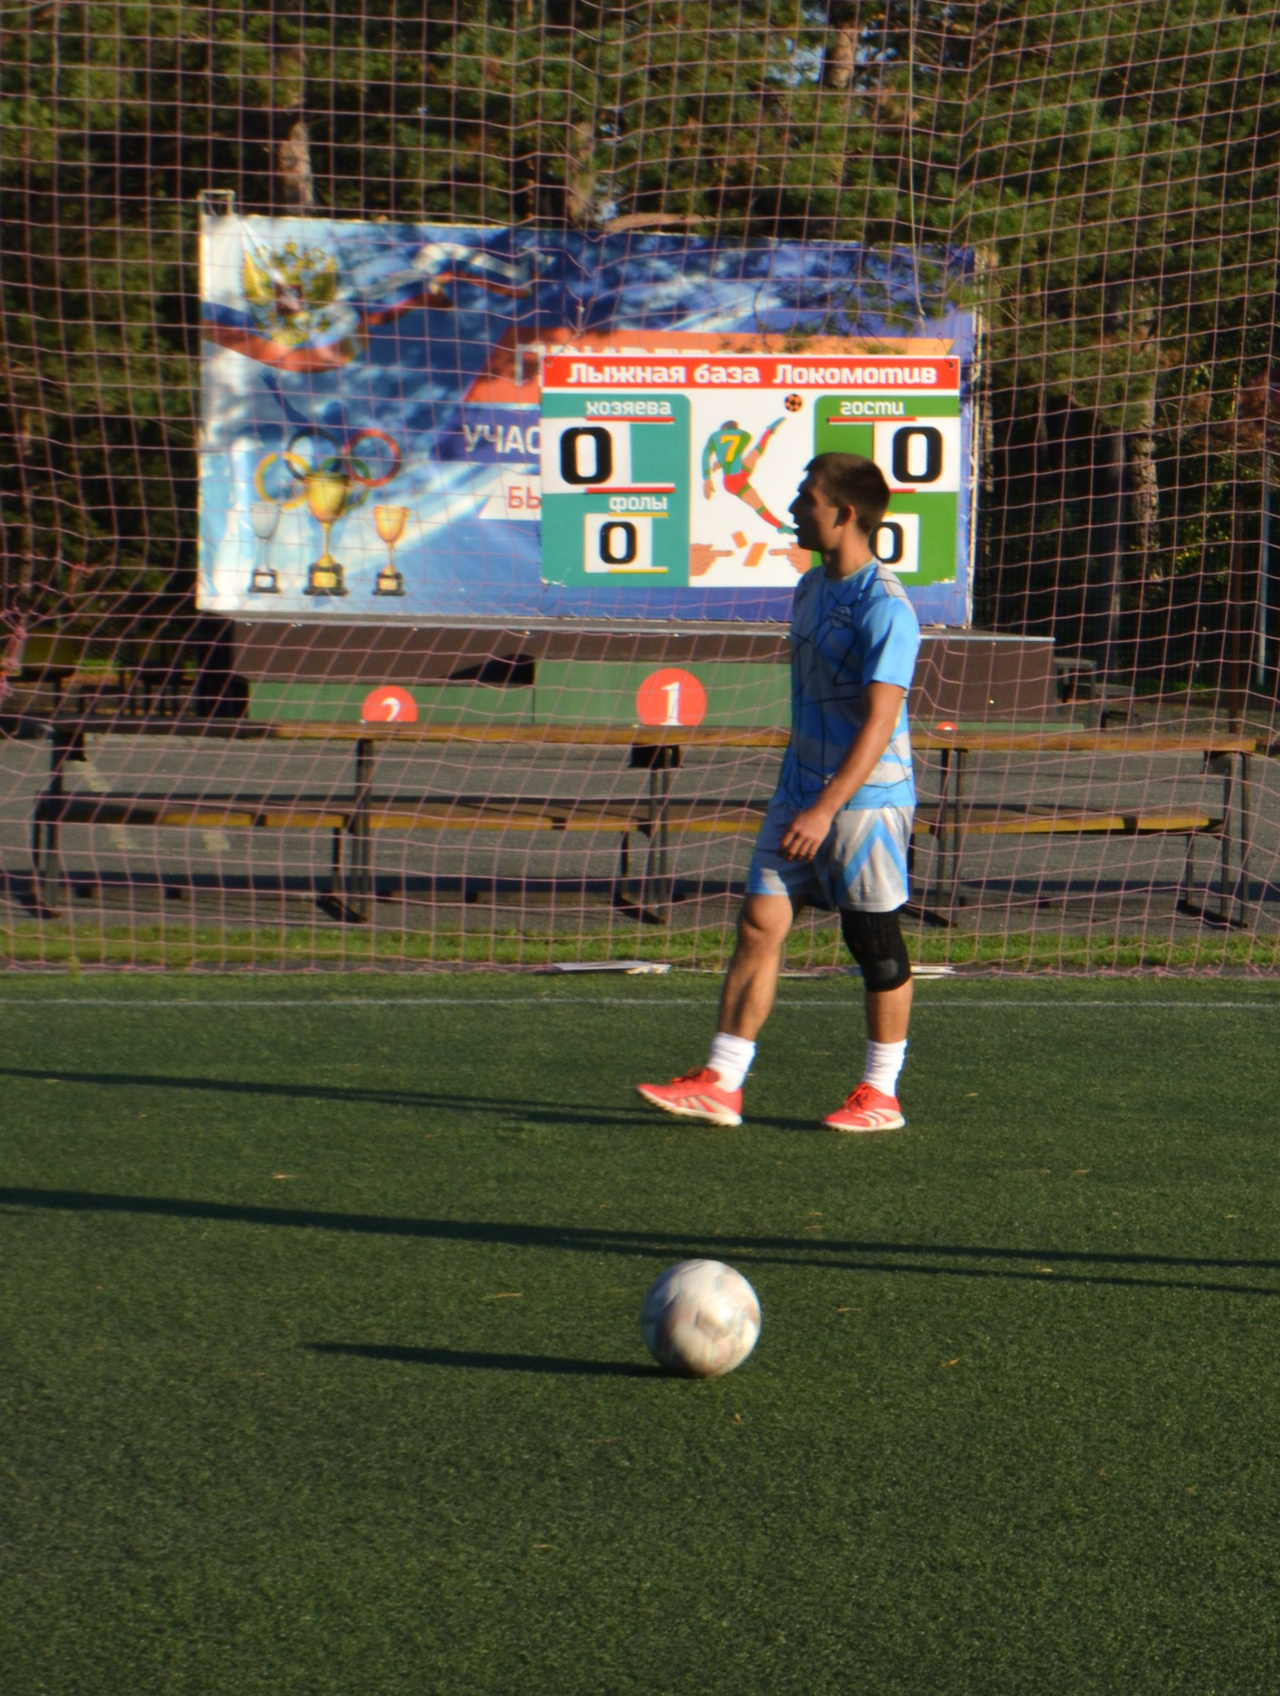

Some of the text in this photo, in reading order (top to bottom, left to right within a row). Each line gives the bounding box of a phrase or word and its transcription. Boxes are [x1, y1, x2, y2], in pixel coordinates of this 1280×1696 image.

[567, 363, 938, 384] Лыжная база Локомотив
[585, 400, 672, 415] хозяева
[840, 401, 904, 415] гости
[560, 426, 613, 485] 0
[719, 435, 742, 462] 7
[892, 426, 943, 483] 0
[609, 496, 668, 513] фолы
[599, 521, 637, 565] 0
[661, 681, 683, 726] 1
